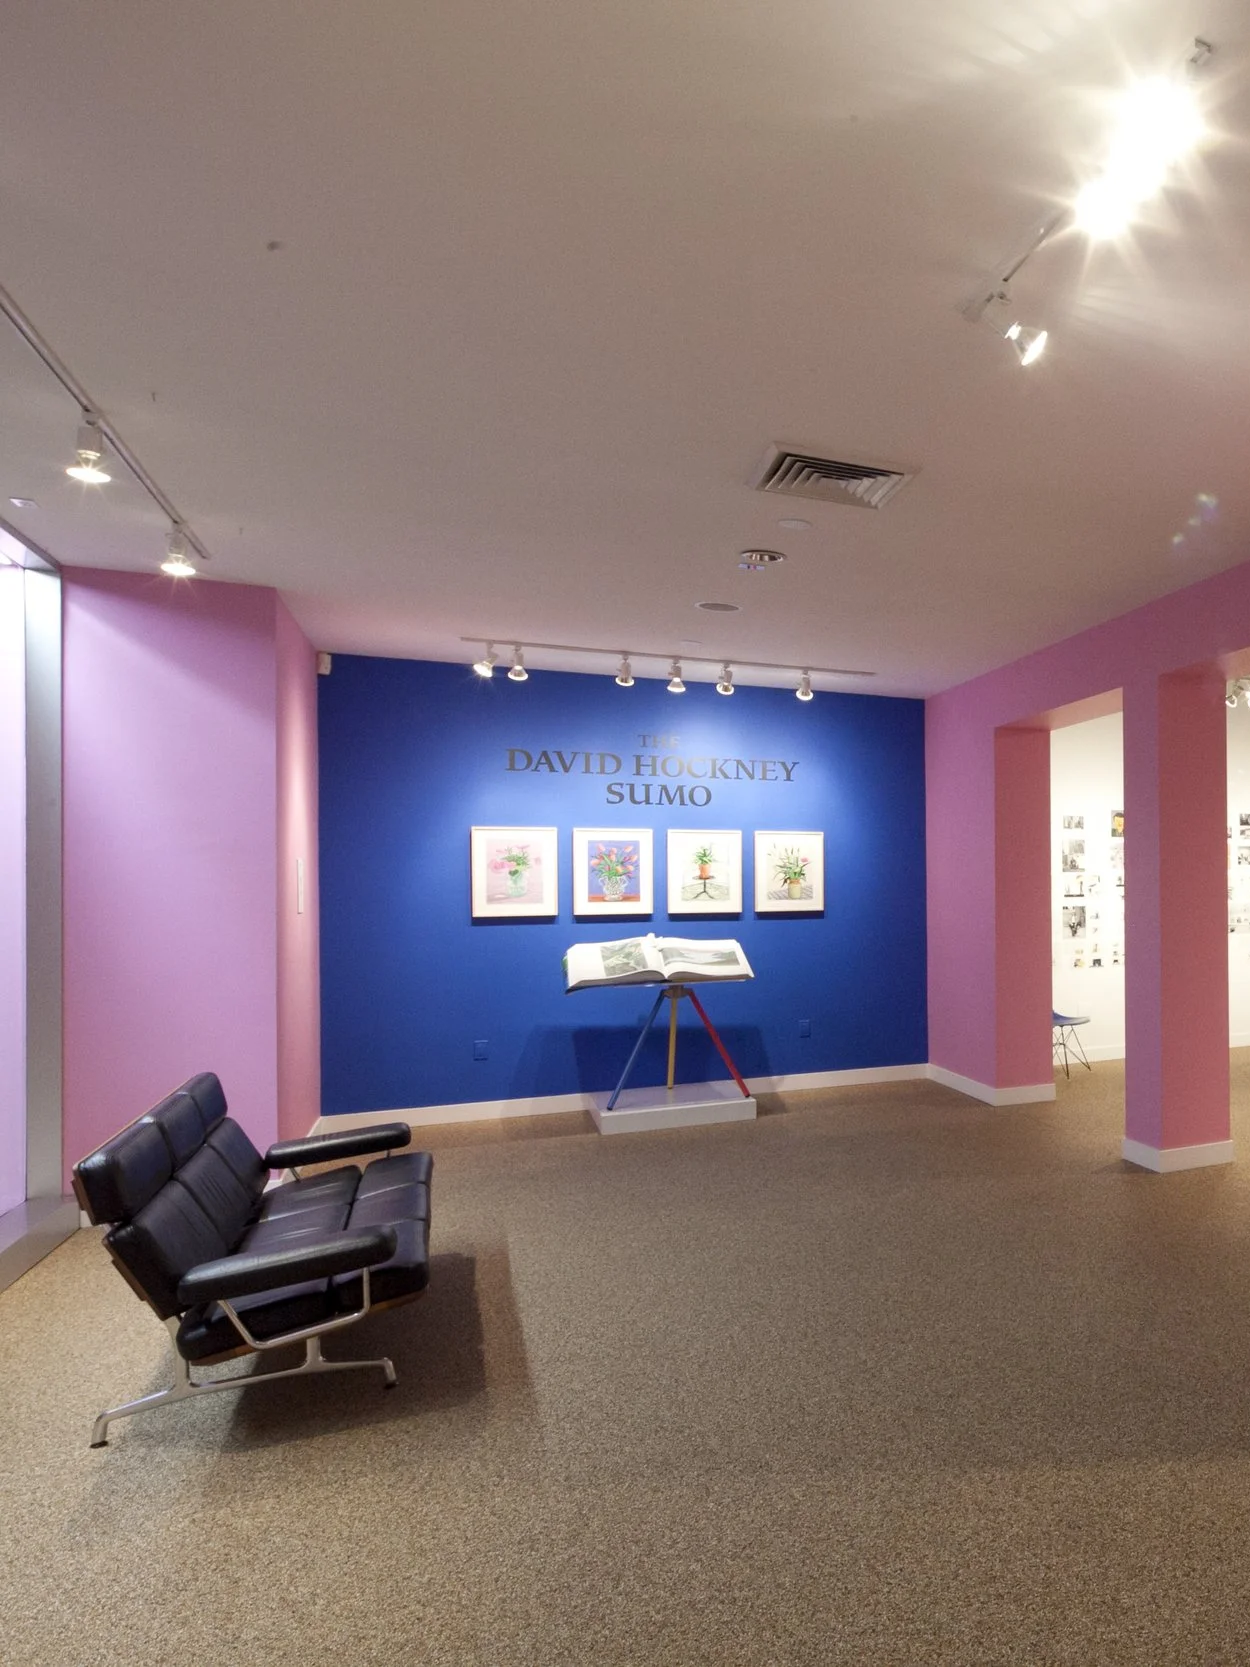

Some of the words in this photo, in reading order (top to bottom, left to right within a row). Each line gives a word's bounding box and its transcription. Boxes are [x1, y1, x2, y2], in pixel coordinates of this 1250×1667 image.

[638, 734, 681, 749] THE
[505, 748, 622, 775] DAVID
[632, 754, 799, 781] HOCKNEY
[606, 782, 713, 807] SUMO
